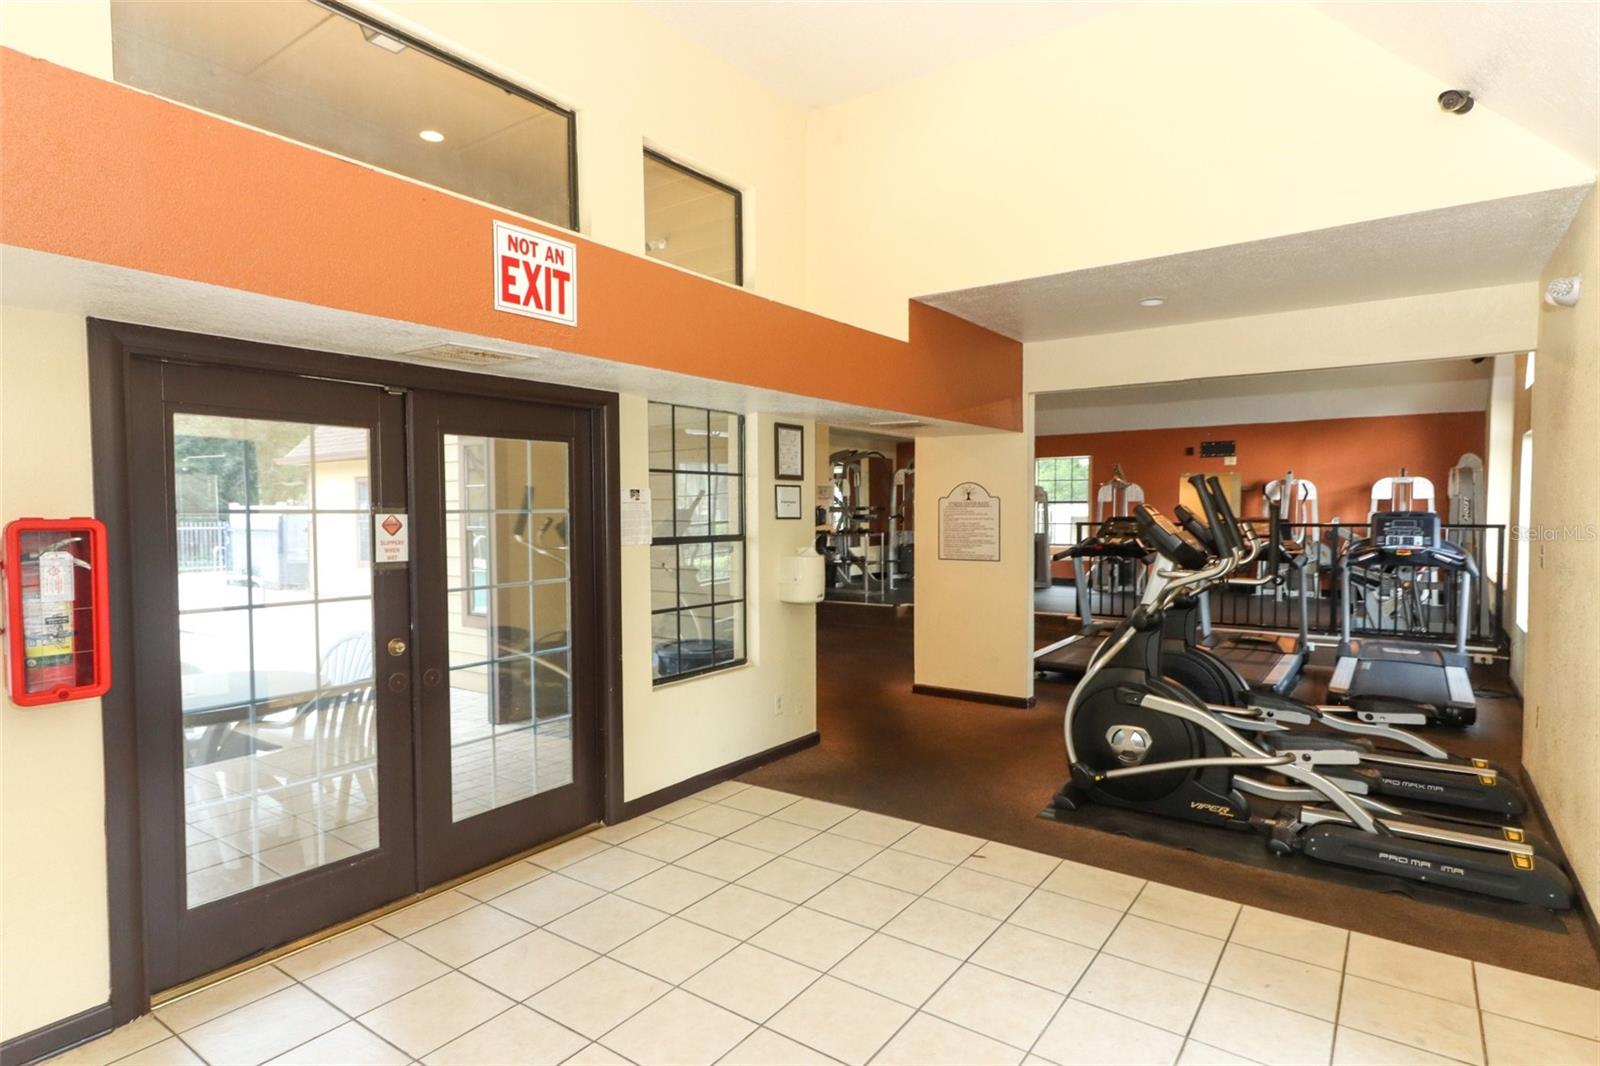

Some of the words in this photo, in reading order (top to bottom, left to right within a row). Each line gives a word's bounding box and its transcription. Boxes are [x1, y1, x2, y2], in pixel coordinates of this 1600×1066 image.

[507, 234, 539, 258] NOT
[545, 246, 564, 266] AN
[501, 255, 571, 315] EXIT
[1382, 778, 1401, 786] RO
[1190, 801, 1230, 813] VIPER
[1378, 852, 1409, 864] PRO
[1410, 859, 1465, 876] MAIMA
